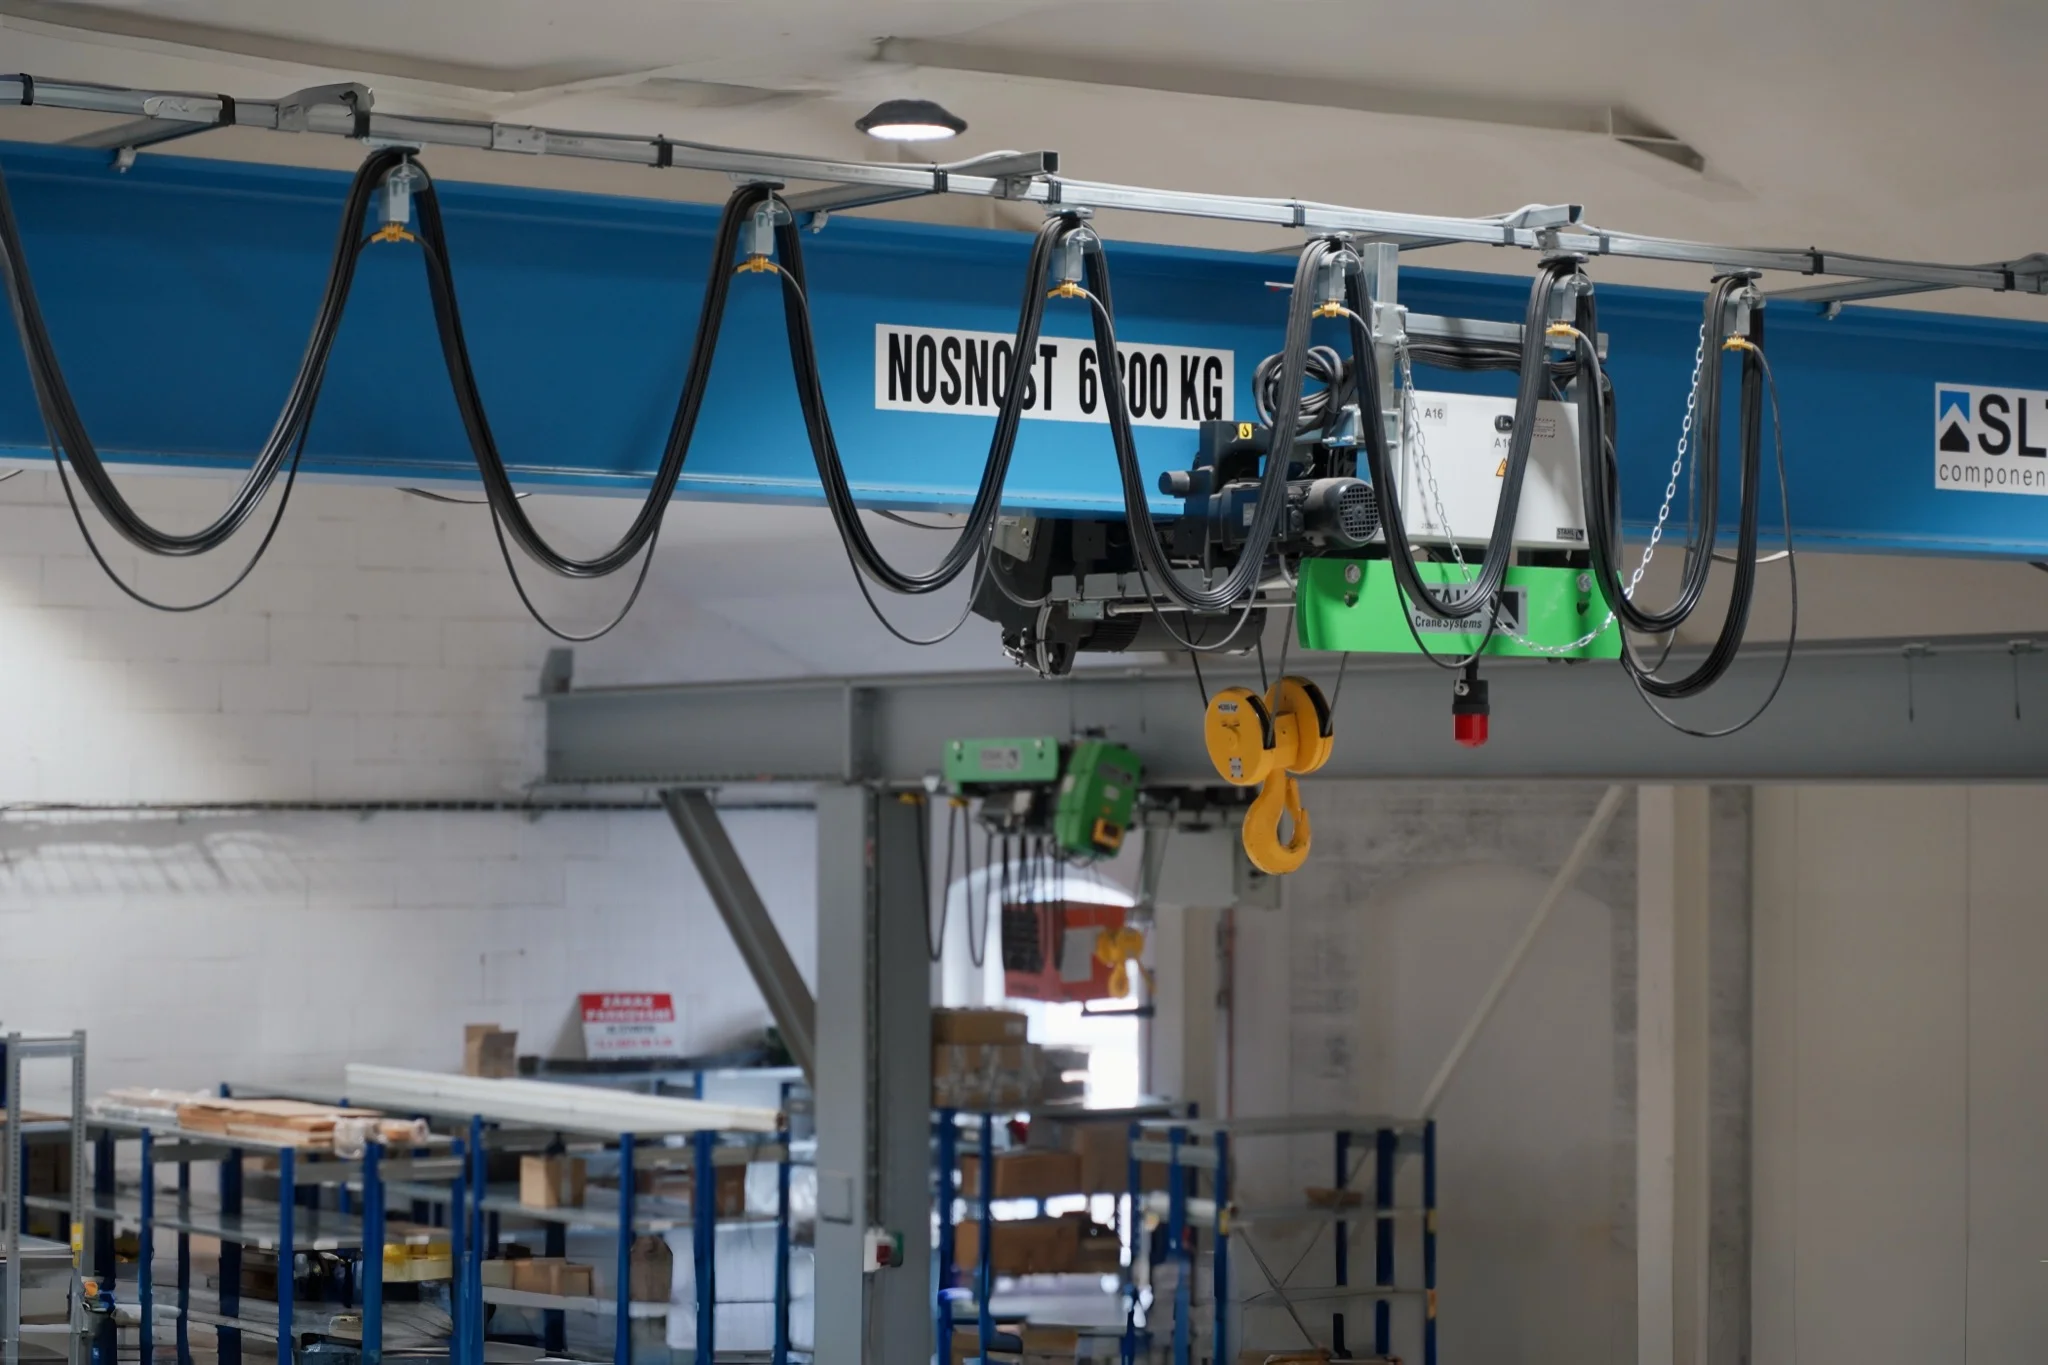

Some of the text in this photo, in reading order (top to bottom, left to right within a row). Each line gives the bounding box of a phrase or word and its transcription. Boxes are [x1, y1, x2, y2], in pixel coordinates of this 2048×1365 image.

[1079, 347, 1168, 419] 600
[1181, 355, 1223, 421] KG
[1425, 407, 1443, 419] A16
[1978, 393, 2048, 458] SL
